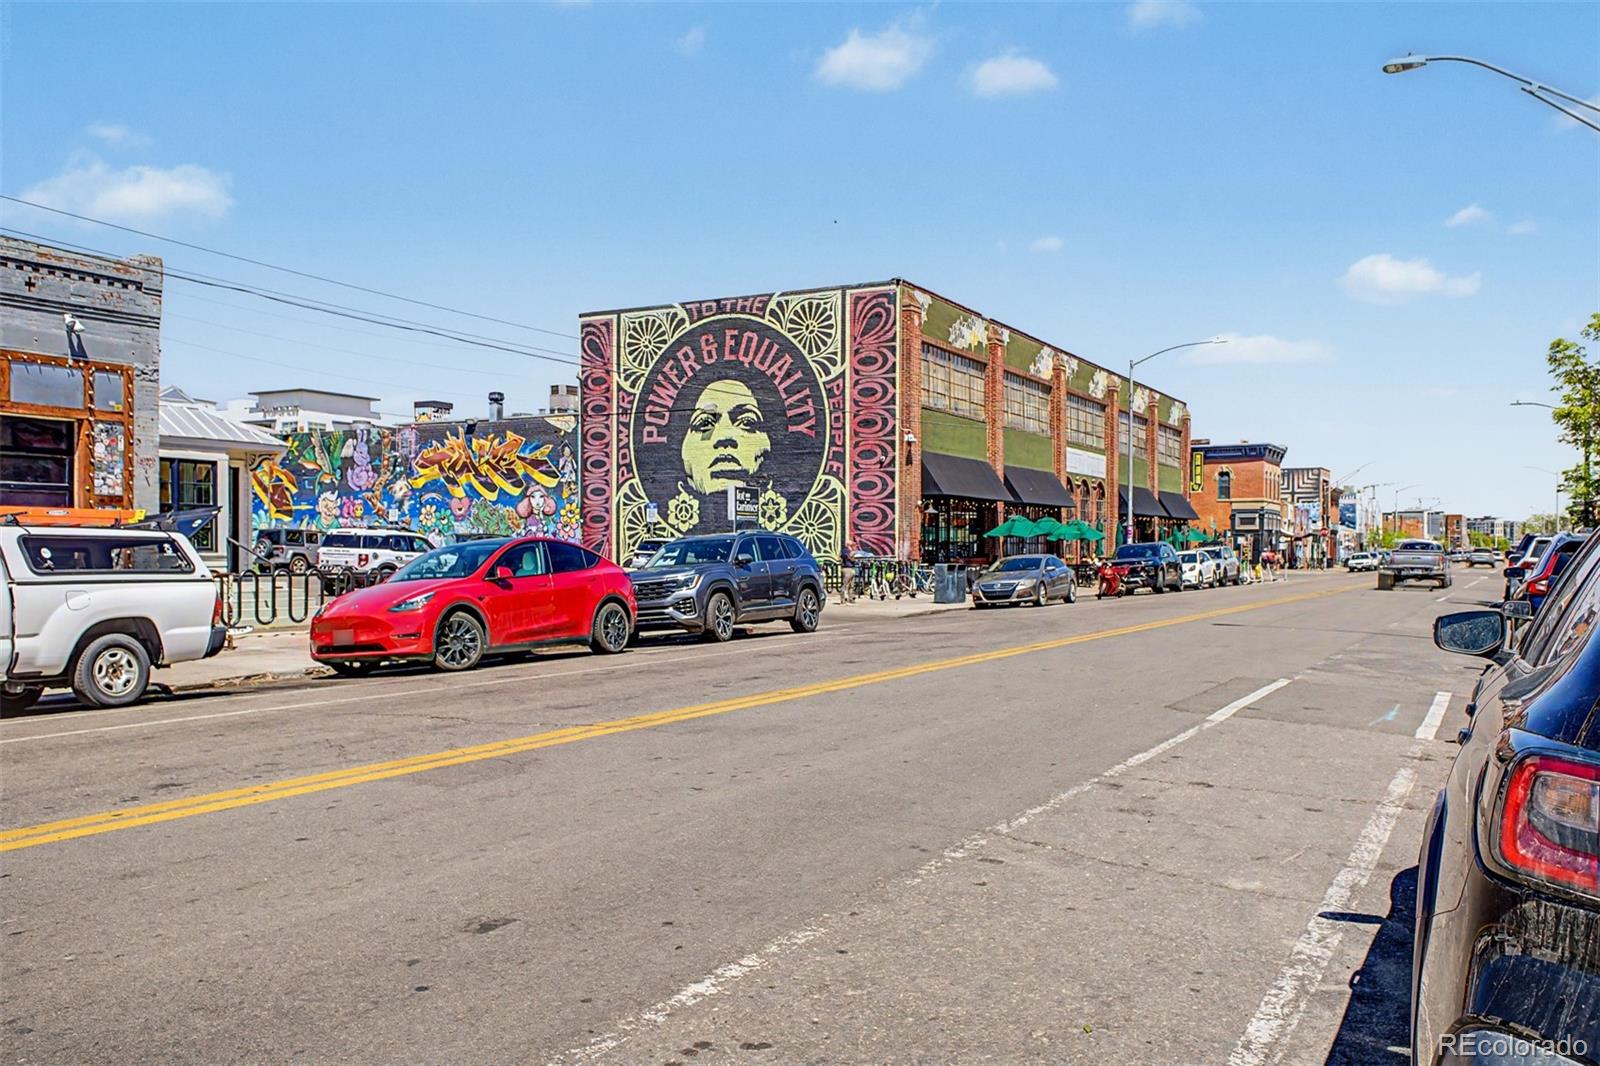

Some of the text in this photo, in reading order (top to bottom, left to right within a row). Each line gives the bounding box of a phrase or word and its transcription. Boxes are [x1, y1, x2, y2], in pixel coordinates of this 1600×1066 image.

[685, 296, 769, 320] TO THE
[643, 328, 816, 444] POWER & EQUALITY
[825, 378, 844, 480] PEOPLE
[618, 389, 634, 484] POWER
